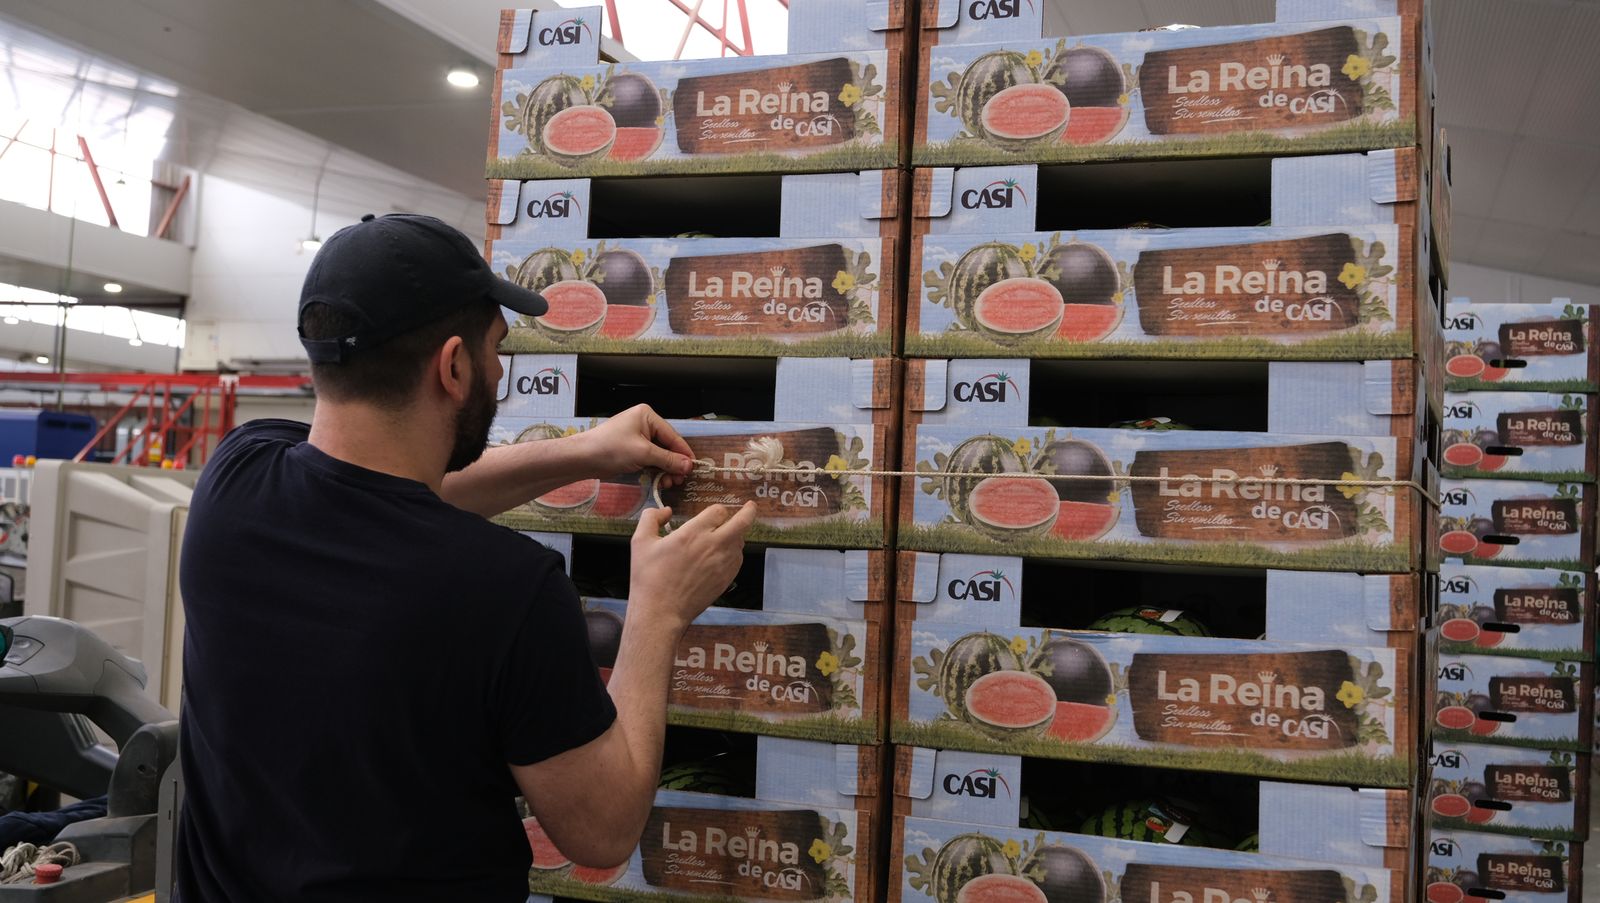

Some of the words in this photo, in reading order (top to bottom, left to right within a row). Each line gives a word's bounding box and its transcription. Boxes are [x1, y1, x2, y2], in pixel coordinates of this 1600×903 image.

[969, 0, 1020, 20] CASI
[539, 26, 581, 46] CASI
[1168, 65, 1209, 94] La
[1219, 62, 1330, 91] Reina
[696, 91, 731, 117] La
[739, 89, 829, 115] Reina
[1172, 96, 1221, 108] Seedless
[1259, 91, 1287, 107] de
[1289, 97, 1335, 114] CASI
[1172, 109, 1193, 119] Sin
[1195, 106, 1241, 118] semillas
[700, 119, 739, 130] Seedless
[771, 115, 793, 130] de
[795, 119, 832, 137] CASI
[699, 130, 718, 140] Sin
[719, 128, 757, 138] semillas
[961, 188, 1013, 209] CASI
[527, 199, 569, 218] CASI
[688, 272, 723, 298] La
[731, 272, 822, 298] Reina
[1163, 266, 1205, 294] La
[1216, 265, 1327, 294] Reina
[692, 301, 732, 311] Seedless
[763, 299, 787, 315] de
[788, 307, 825, 323] CASI
[1168, 298, 1216, 309] Seedless
[1255, 295, 1283, 312] de
[1286, 304, 1331, 320] CASI
[691, 311, 709, 321] Sin
[711, 312, 748, 321] semillas
[1167, 310, 1189, 321] Sin
[1191, 310, 1236, 320] semillas
[1509, 329, 1525, 340] La
[1529, 329, 1571, 341] Reina
[517, 376, 559, 395] CASI
[953, 381, 1006, 402] CASI
[1507, 418, 1524, 429] La
[1527, 419, 1569, 431] Reina
[1159, 467, 1201, 497] La
[1212, 469, 1324, 502] Reina
[756, 482, 779, 498] de
[781, 490, 818, 507] CASI
[1163, 500, 1213, 512] Seedless
[1502, 506, 1519, 518] La
[1522, 507, 1564, 520] Reina
[1163, 512, 1186, 523] Sin
[1188, 514, 1233, 525] semillas
[1252, 502, 1281, 519] de
[1283, 511, 1328, 529] CASI
[948, 579, 1000, 602] CASI
[1504, 595, 1521, 606] La
[1525, 596, 1567, 609] Reina
[713, 643, 806, 678] Reina
[673, 670, 713, 682] Seedless
[1438, 667, 1464, 681] ASI
[673, 681, 691, 691] Sin
[692, 684, 730, 695] semillas
[746, 675, 770, 692] de
[771, 685, 809, 703] CASI
[1158, 670, 1199, 702] La
[1210, 674, 1324, 711] Reina
[1500, 683, 1516, 694] La
[1520, 685, 1563, 698] Reina
[1162, 704, 1211, 717] Seedless
[1161, 716, 1183, 727] Sin
[1185, 720, 1231, 731] semillas
[1251, 708, 1280, 727] de
[1282, 719, 1328, 739] CASI
[943, 774, 996, 799] CASI
[1495, 771, 1512, 783] La
[1515, 773, 1558, 787] Reina
[663, 822, 697, 852] La
[705, 827, 799, 865] Reina
[1430, 842, 1452, 857] ASI
[666, 853, 705, 866] Seedless
[665, 865, 685, 875] Sin
[686, 868, 722, 880] semillas
[738, 860, 762, 878] de
[763, 871, 801, 890] CASI
[1488, 860, 1504, 872] La
[1508, 862, 1551, 878] Reina
[1523, 875, 1534, 883] de
